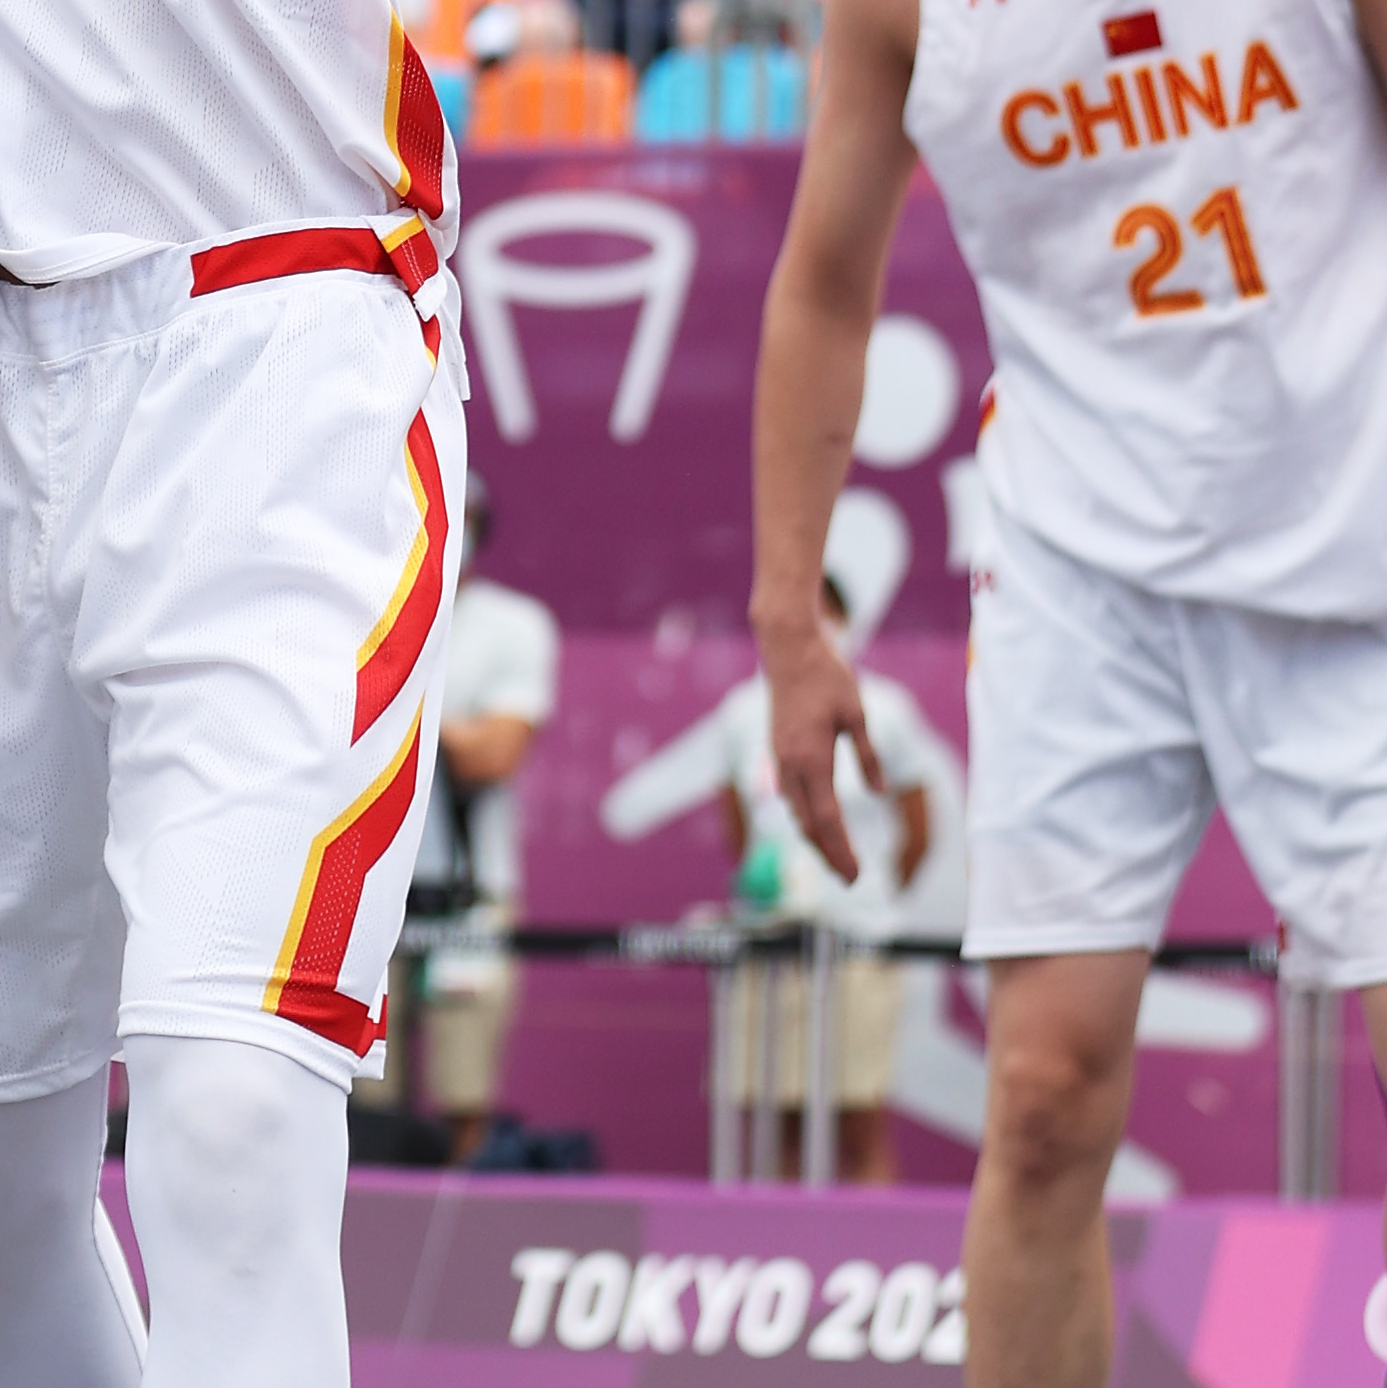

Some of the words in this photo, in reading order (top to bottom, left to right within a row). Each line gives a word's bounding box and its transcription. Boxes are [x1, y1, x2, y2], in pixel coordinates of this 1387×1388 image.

[1001, 40, 1300, 168] CHINA
[1112, 185, 1269, 322] 21
[509, 1248, 815, 1357] TOKYO
[808, 1260, 966, 1365] 202
